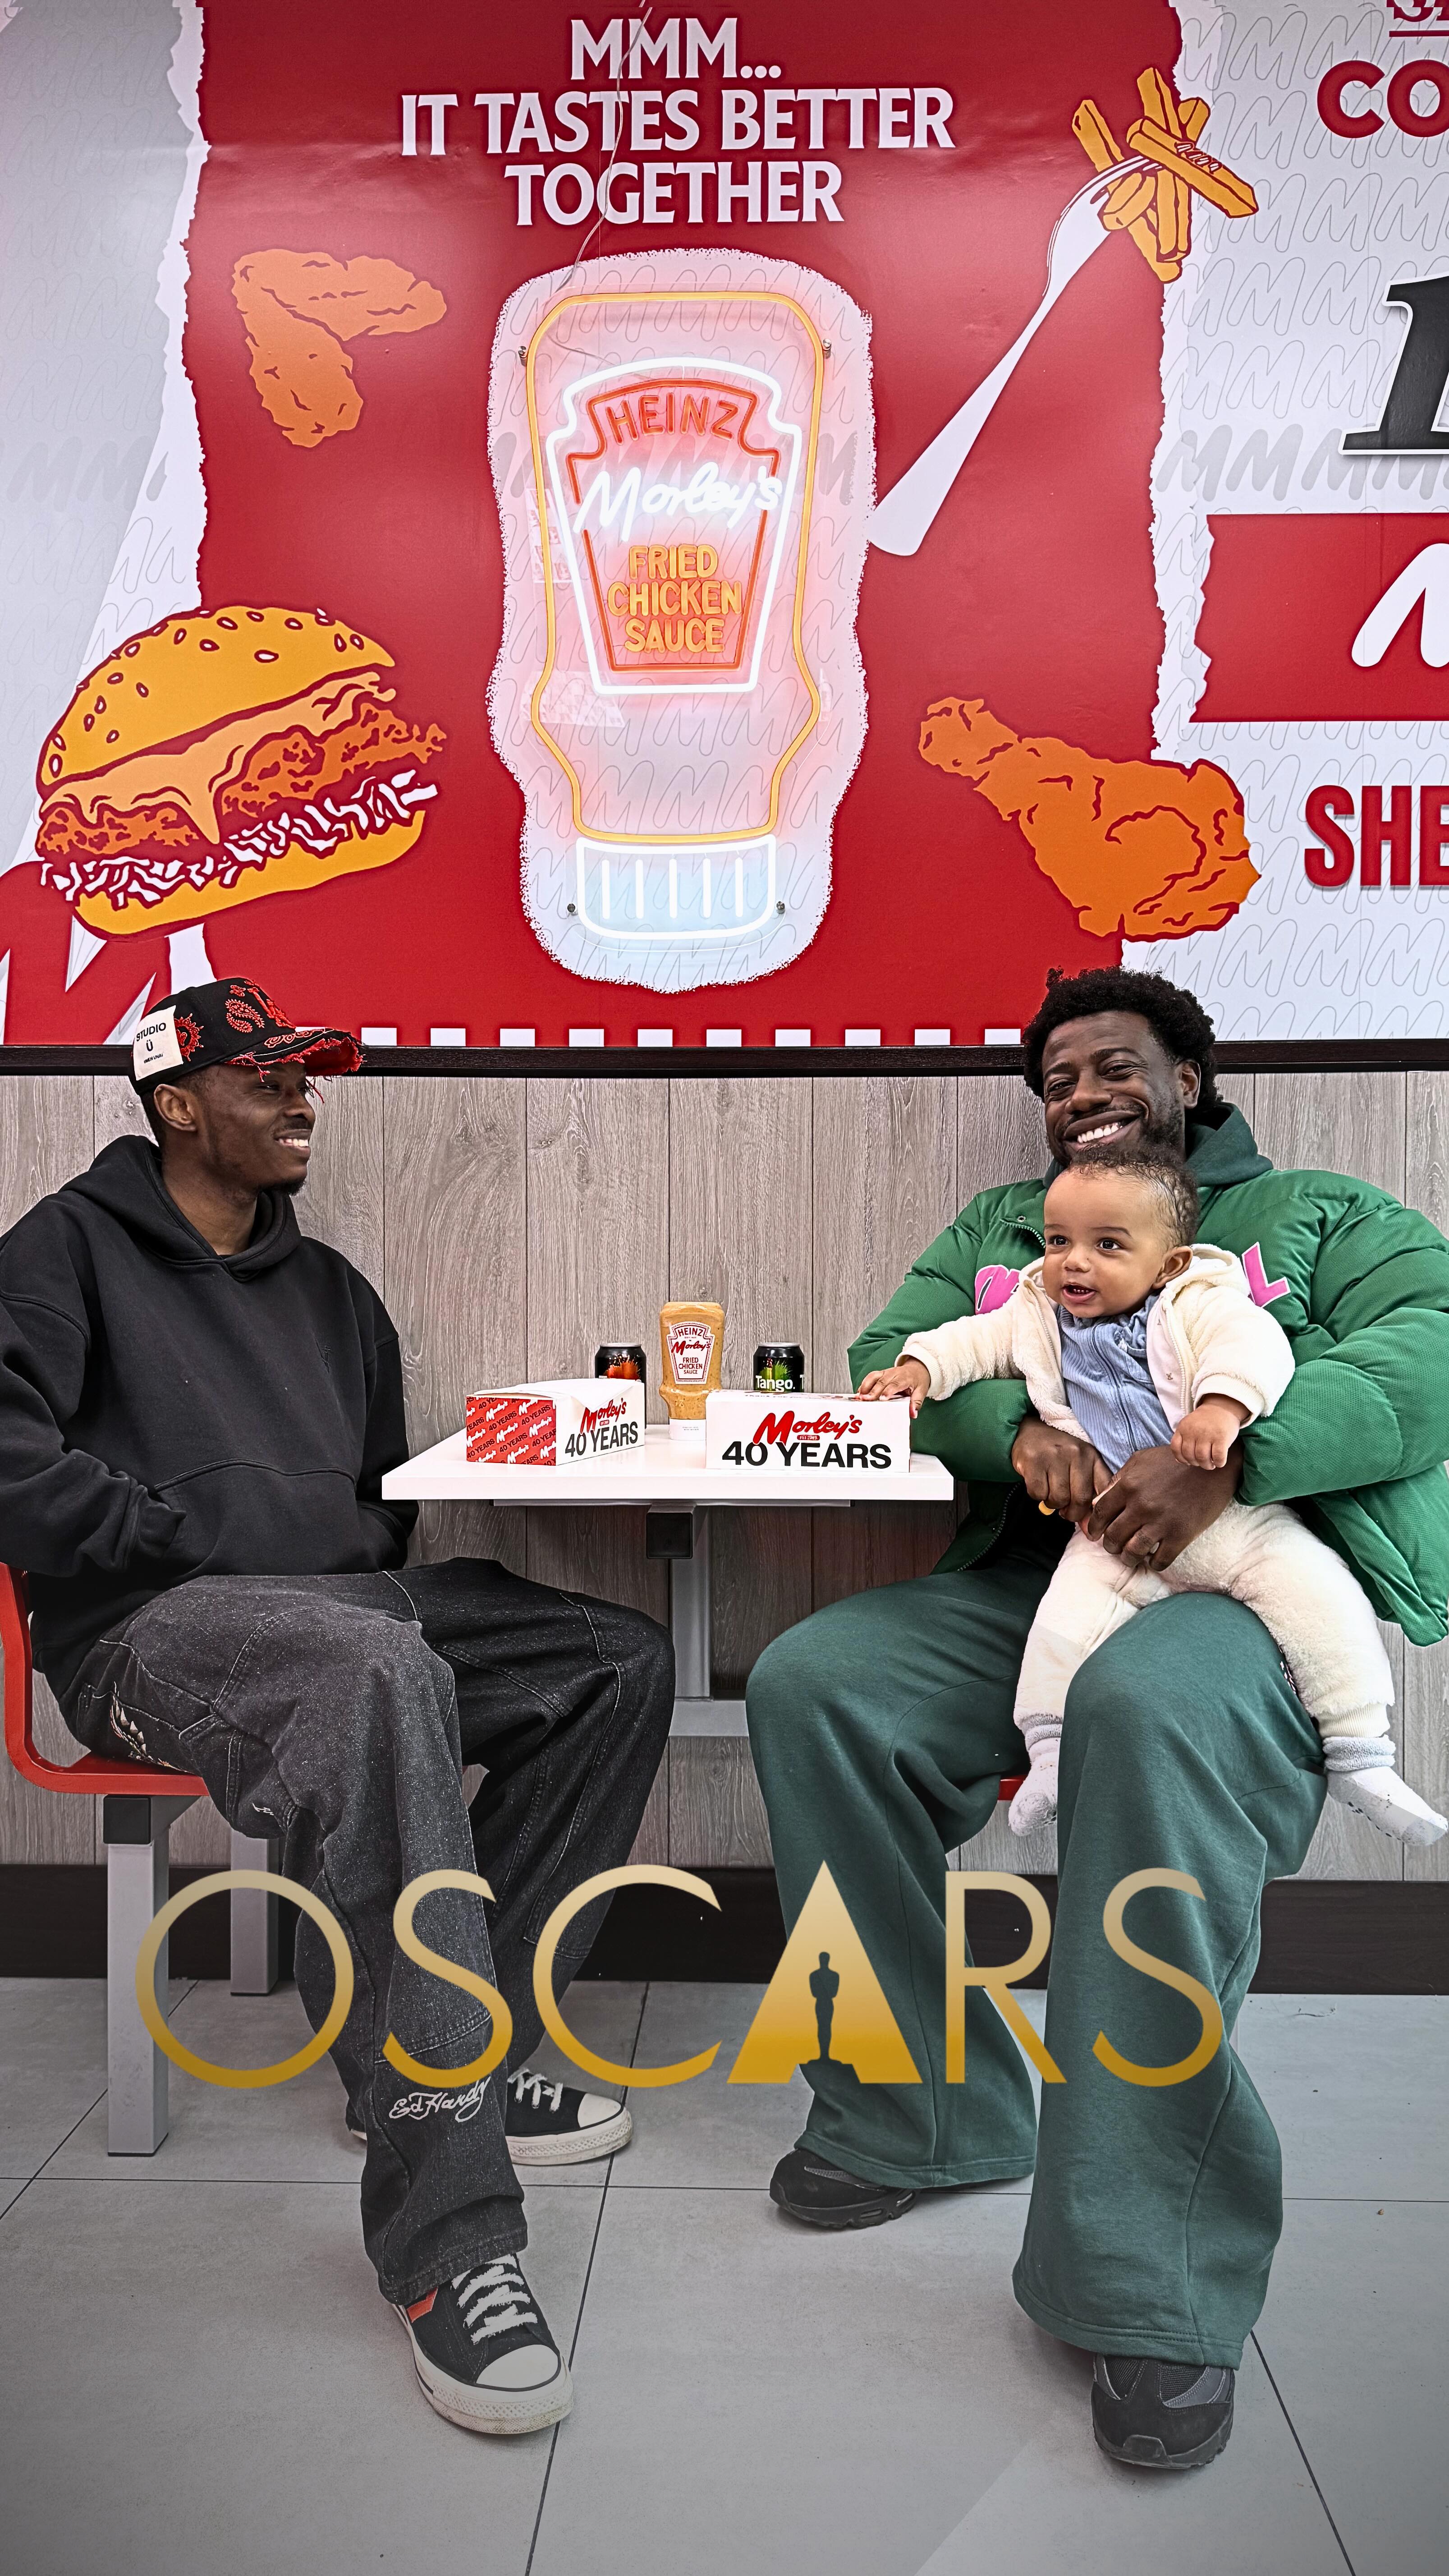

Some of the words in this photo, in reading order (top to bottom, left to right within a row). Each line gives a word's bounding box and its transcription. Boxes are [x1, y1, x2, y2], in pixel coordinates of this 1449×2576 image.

[571, 17, 781, 80] MMM...
[401, 93, 458, 156] IT
[474, 90, 700, 153] TASTES
[721, 87, 956, 150] BETTER
[504, 161, 844, 226] TOGETHER
[605, 391, 739, 446] HEINZ
[573, 461, 783, 542] Morley's
[629, 544, 718, 580] FRIED
[607, 580, 743, 616] CHICKEN
[624, 617, 724, 653] SAUCE
[136, 1022, 166, 1042] STUDIO
[671, 1340, 711, 1355] Morley's
[678, 1327, 703, 1337] HEINZ
[580, 1398, 627, 1434] Morley's
[752, 1410, 862, 1446] Morley's
[565, 1432, 587, 1457] 40
[590, 1421, 638, 1452] YEARS
[722, 1441, 768, 1466] 40
[775, 1441, 892, 1469] YEARS
[408, 2076, 491, 2122] Hardy
